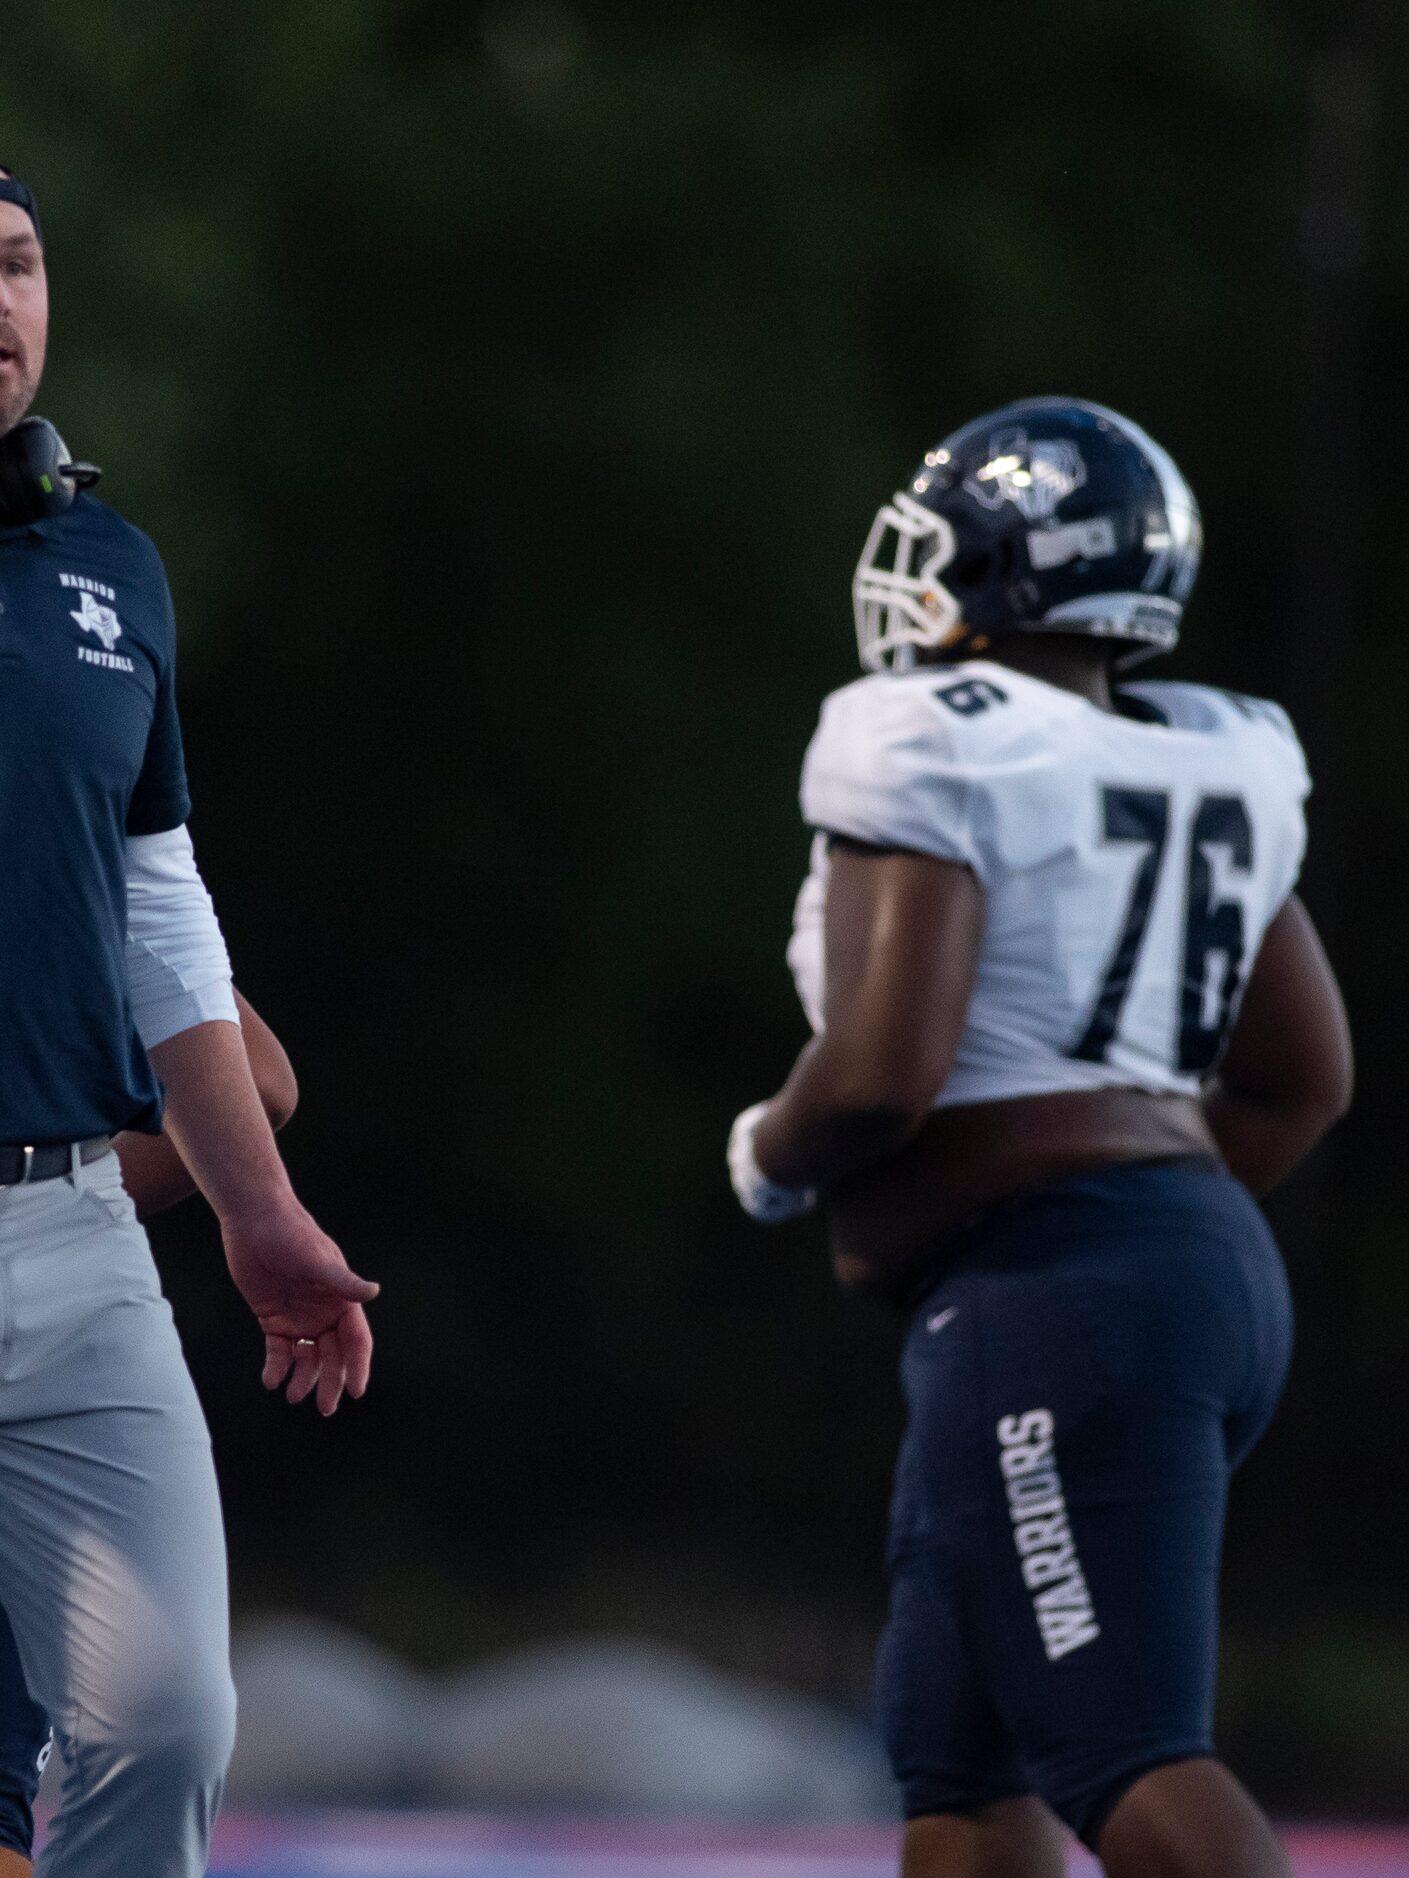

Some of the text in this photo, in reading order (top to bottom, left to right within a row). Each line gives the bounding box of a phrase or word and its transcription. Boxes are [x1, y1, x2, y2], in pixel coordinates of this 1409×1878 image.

[58, 573, 116, 601] WARRIOR
[77, 646, 135, 673] FOOTBALL
[934, 680, 1008, 717] 6
[1070, 787, 1253, 1070] 76
[996, 1407, 1102, 1662] WARRIORS
